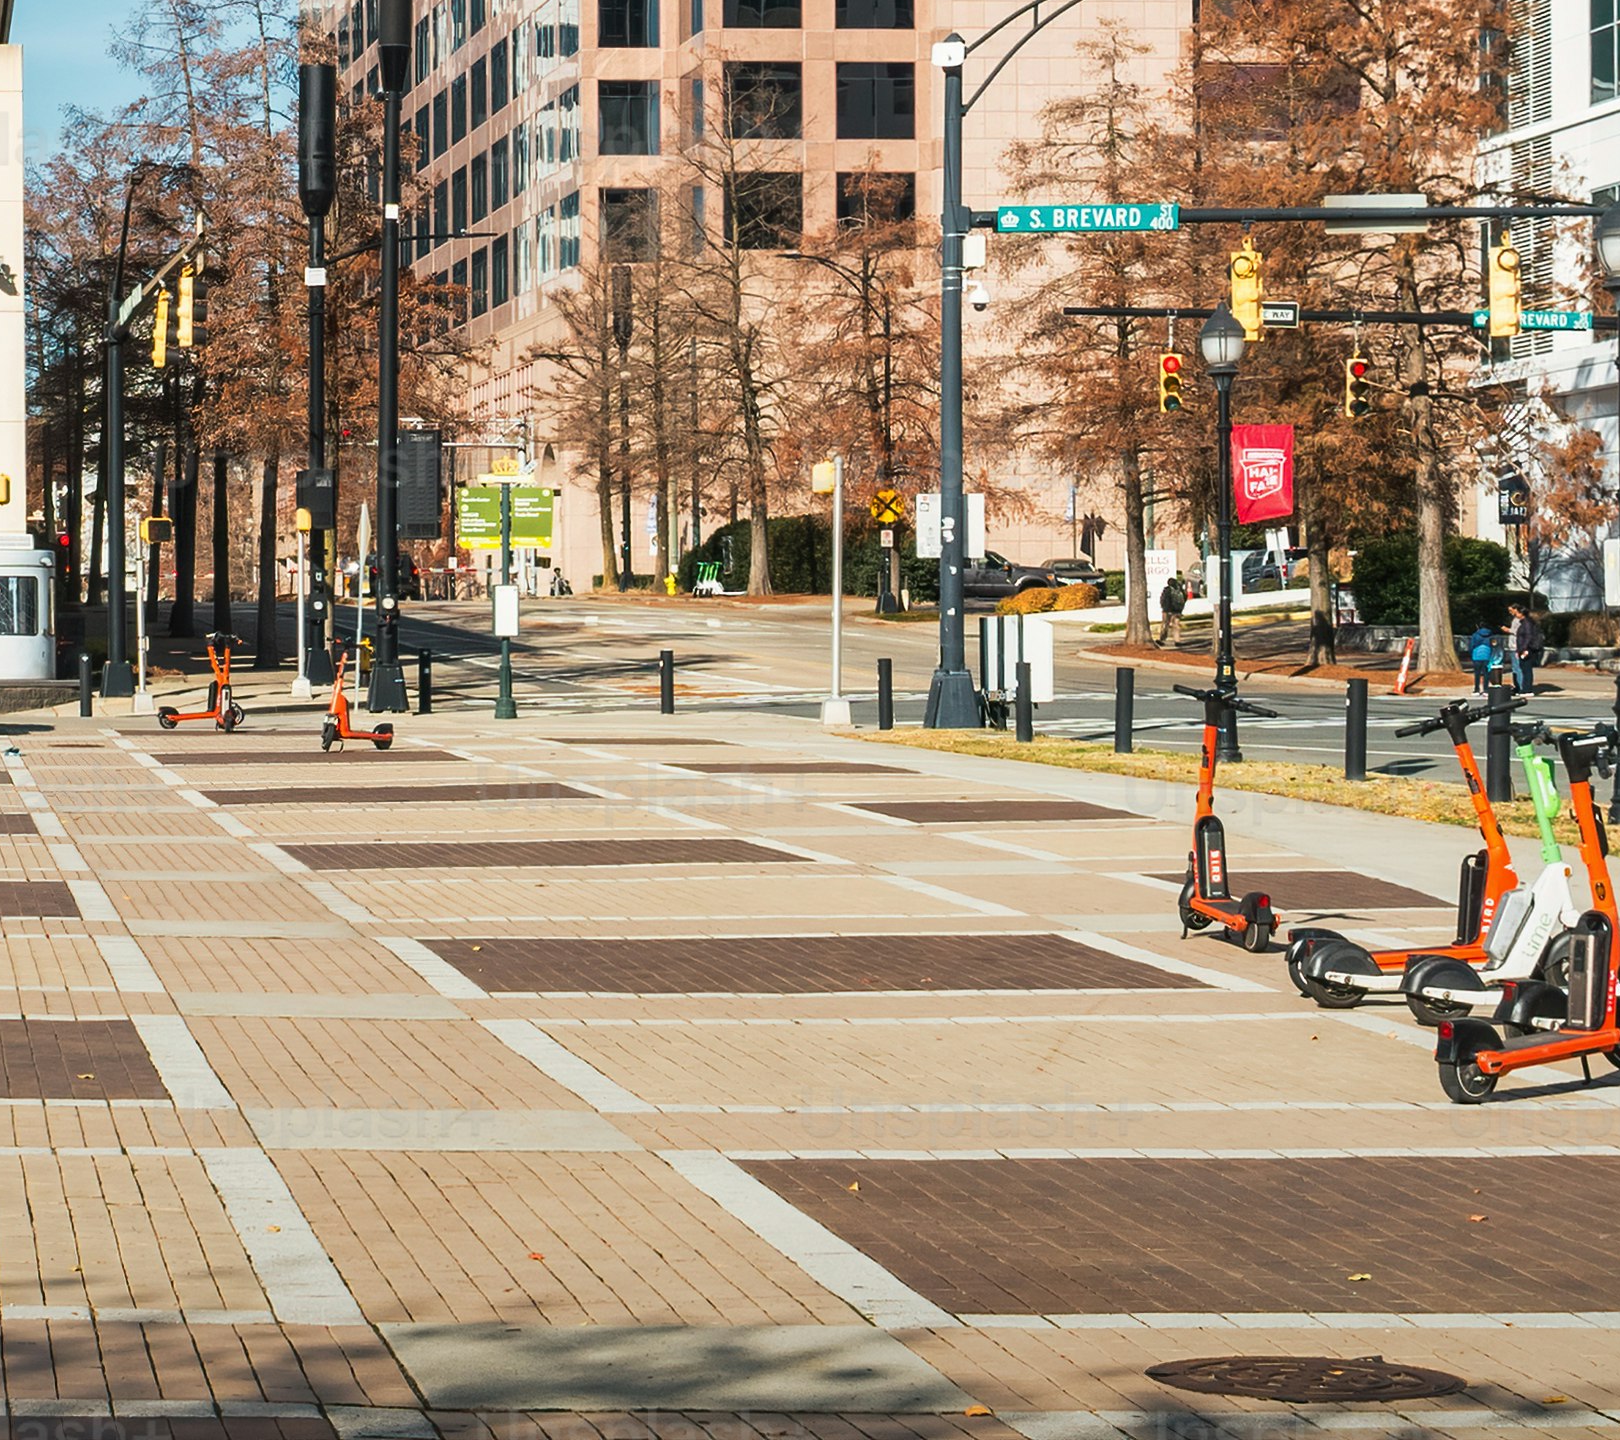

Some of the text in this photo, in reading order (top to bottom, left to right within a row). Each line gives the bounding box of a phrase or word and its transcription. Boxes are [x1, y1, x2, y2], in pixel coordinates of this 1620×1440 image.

[1029, 207, 1142, 229] S. BREVARD
[1160, 204, 1175, 217] ST
[1150, 216, 1175, 230] 400
[1272, 311, 1291, 319] WAY
[1519, 312, 1568, 328] REVARD
[1209, 850, 1221, 883] BIRD
[1481, 898, 1495, 934] BIRD
[1521, 912, 1552, 958] Lime
